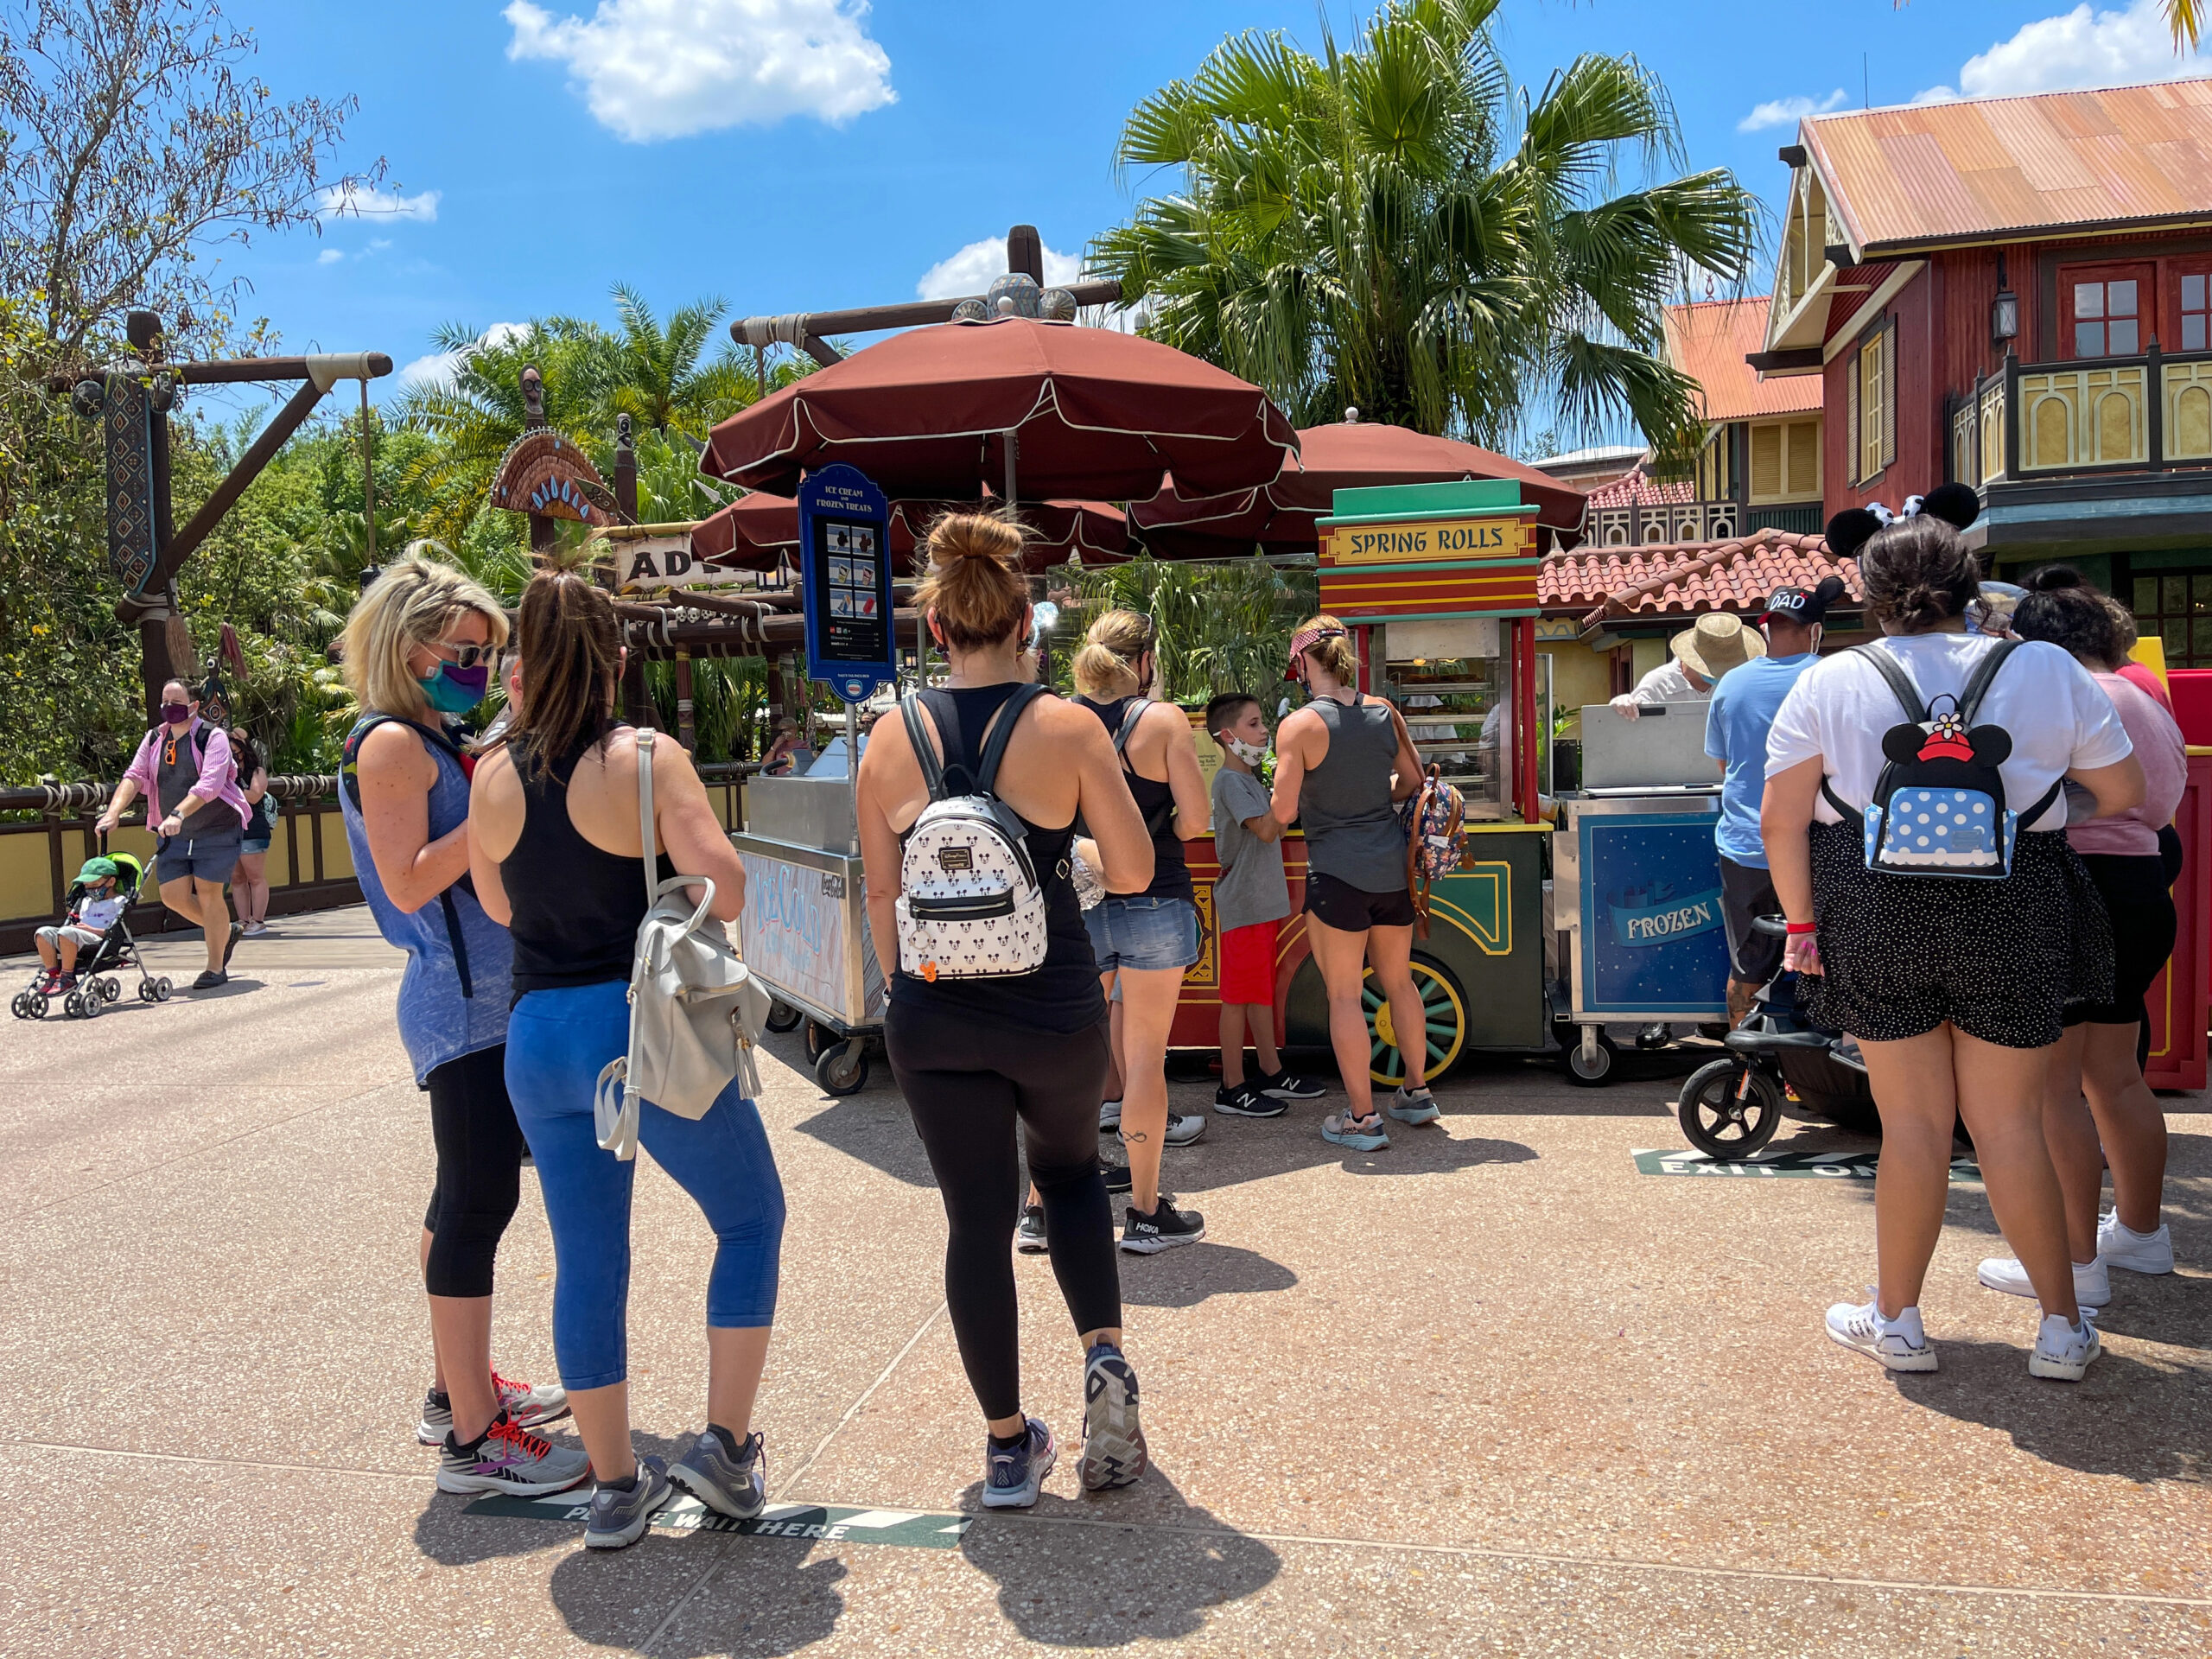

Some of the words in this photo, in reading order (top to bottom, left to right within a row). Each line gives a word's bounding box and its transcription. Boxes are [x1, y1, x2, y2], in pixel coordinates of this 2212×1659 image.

[824, 486, 837, 494] ICE
[838, 487, 863, 498] CREAM
[816, 499, 844, 509] FROZEN
[845, 502, 873, 512] TREATS
[1351, 531, 1427, 555] SPRING
[1438, 527, 1503, 550] ROLLS
[1770, 591, 1806, 611] DAD
[754, 870, 780, 934] ICE
[778, 865, 821, 957] COLD
[1627, 901, 1712, 940] FROZEN
[1658, 1160, 1783, 1176] EXIT
[1135, 1222, 1159, 1235] HOKA
[754, 1520, 851, 1541] HERE
